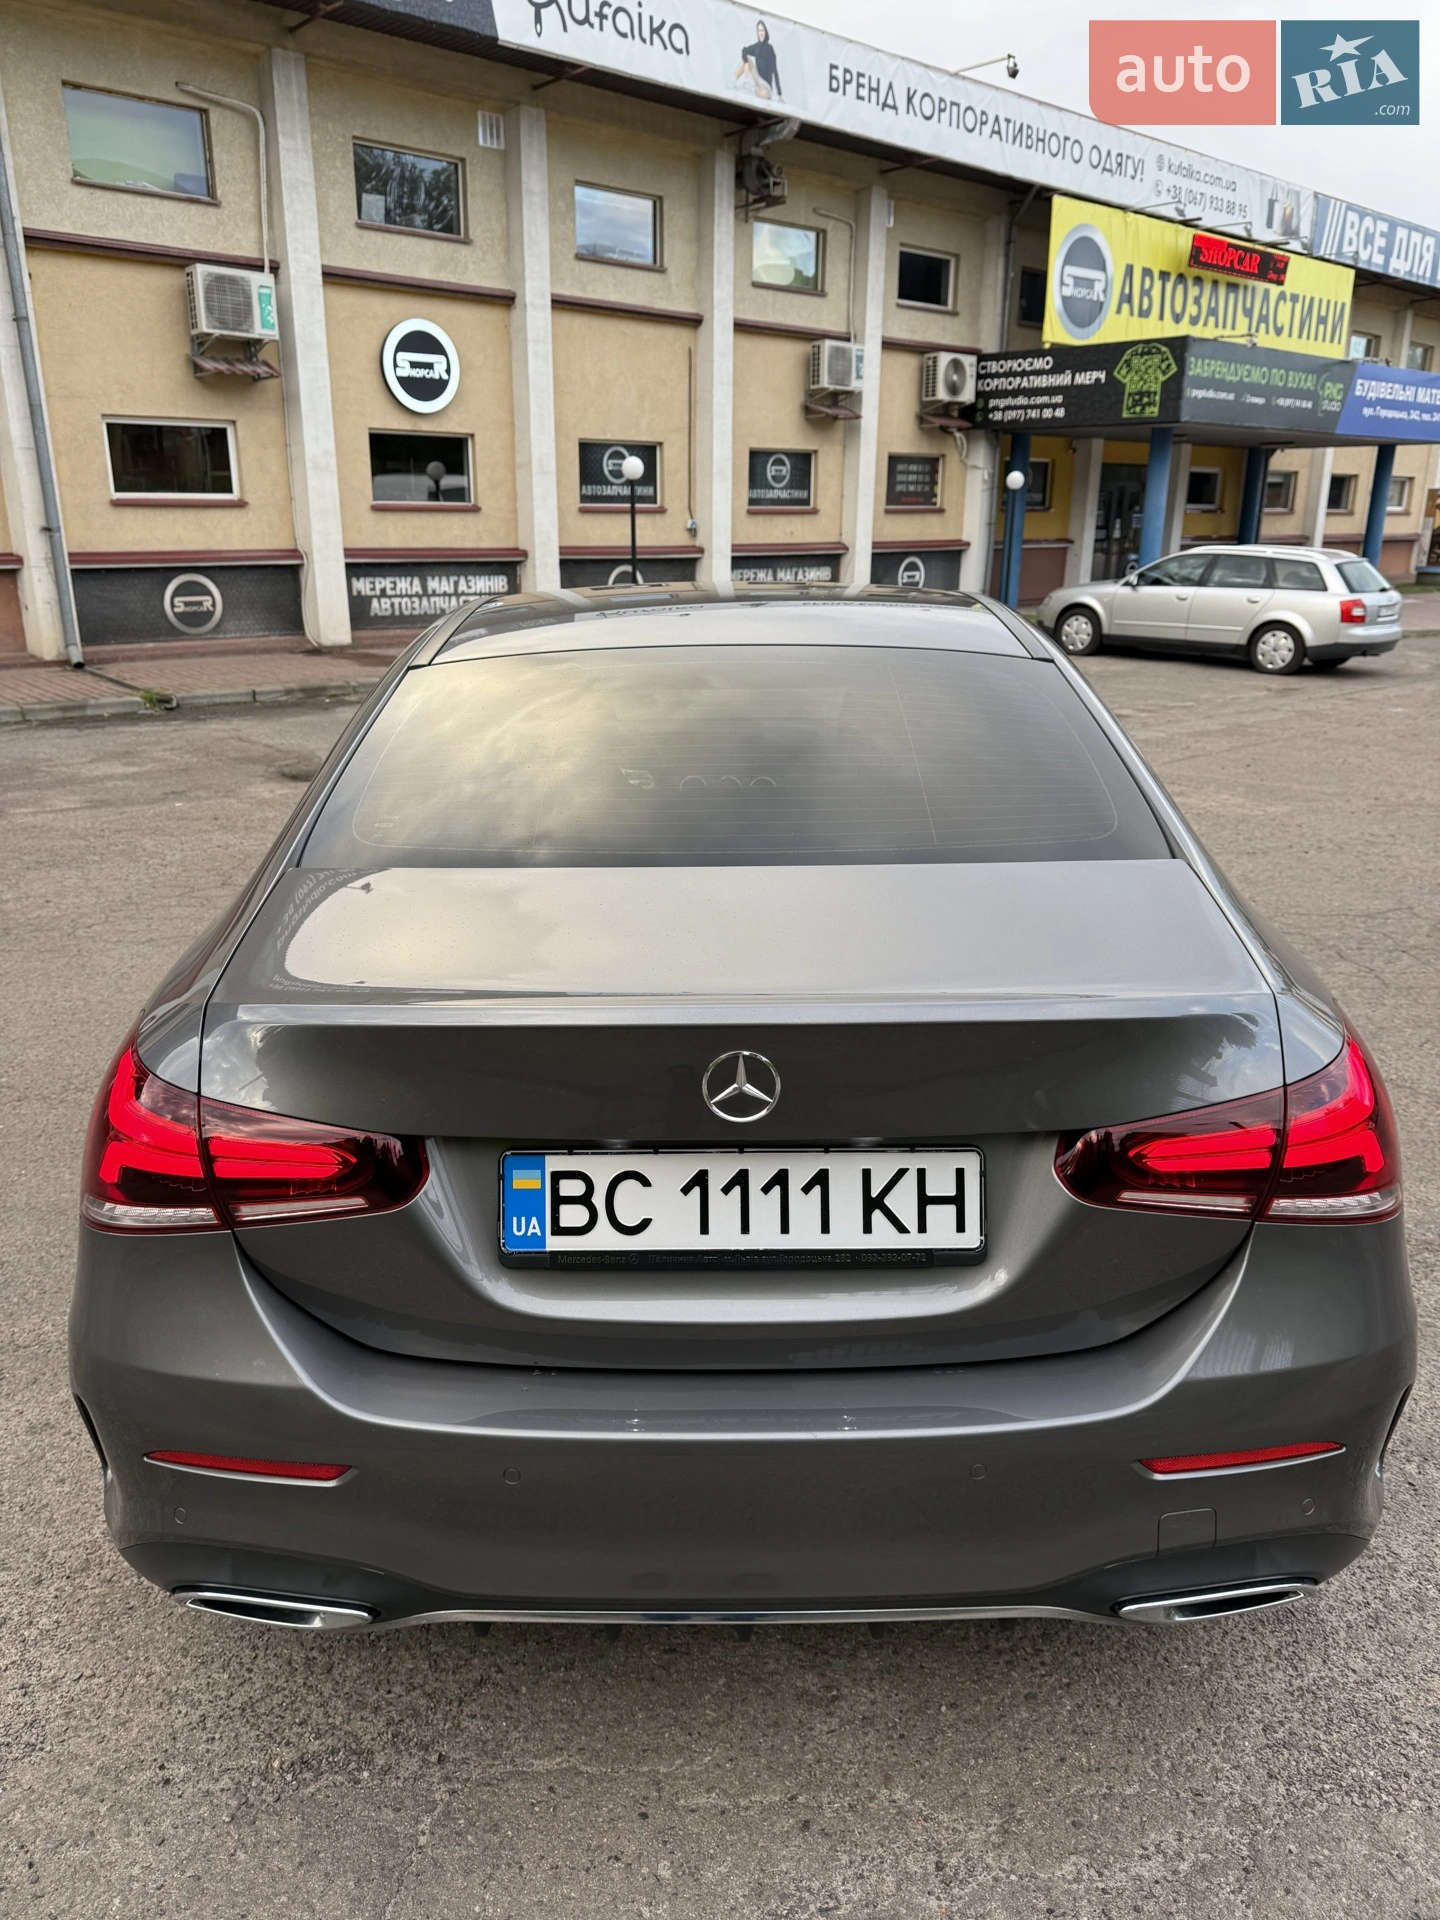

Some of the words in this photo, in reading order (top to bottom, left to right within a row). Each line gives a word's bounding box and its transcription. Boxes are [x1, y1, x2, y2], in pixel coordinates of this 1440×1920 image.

[829, 62, 899, 116] БРЕНД
[906, 86, 1084, 165] КОРПОРАТИВНОГО
[1089, 145, 1145, 183] ОДЯГУ!
[1342, 210, 1389, 265] ВСЕ
[1389, 226, 1436, 278] ДЛЯ
[1199, 246, 1261, 274] SHOPCAR
[1115, 263, 1347, 345] АВТОЗАПЧАСТИНИ
[978, 356, 1054, 374] СТВОРЮЄМО
[1187, 356, 1268, 385] ЗАБРЕНДУЄМО
[977, 370, 1072, 392] КОРПОРАТИВНИЙ
[1073, 369, 1107, 385] МЕРЧ
[1354, 379, 1416, 402] БУДІВЕЛЬНІ
[988, 394, 1064, 410] pngstudio.com.ua
[351, 576, 423, 596] МЕРЕЖА
[427, 575, 509, 595] МАГАЗИНІВ
[550, 1168, 653, 1237] BC
[680, 1168, 830, 1235] 1111
[862, 1167, 966, 1234] KH
[512, 1216, 542, 1237] UA
[558, 1254, 626, 1264] Mercedes-Benz
[861, 1252, 927, 1263] 032-232-07-72
